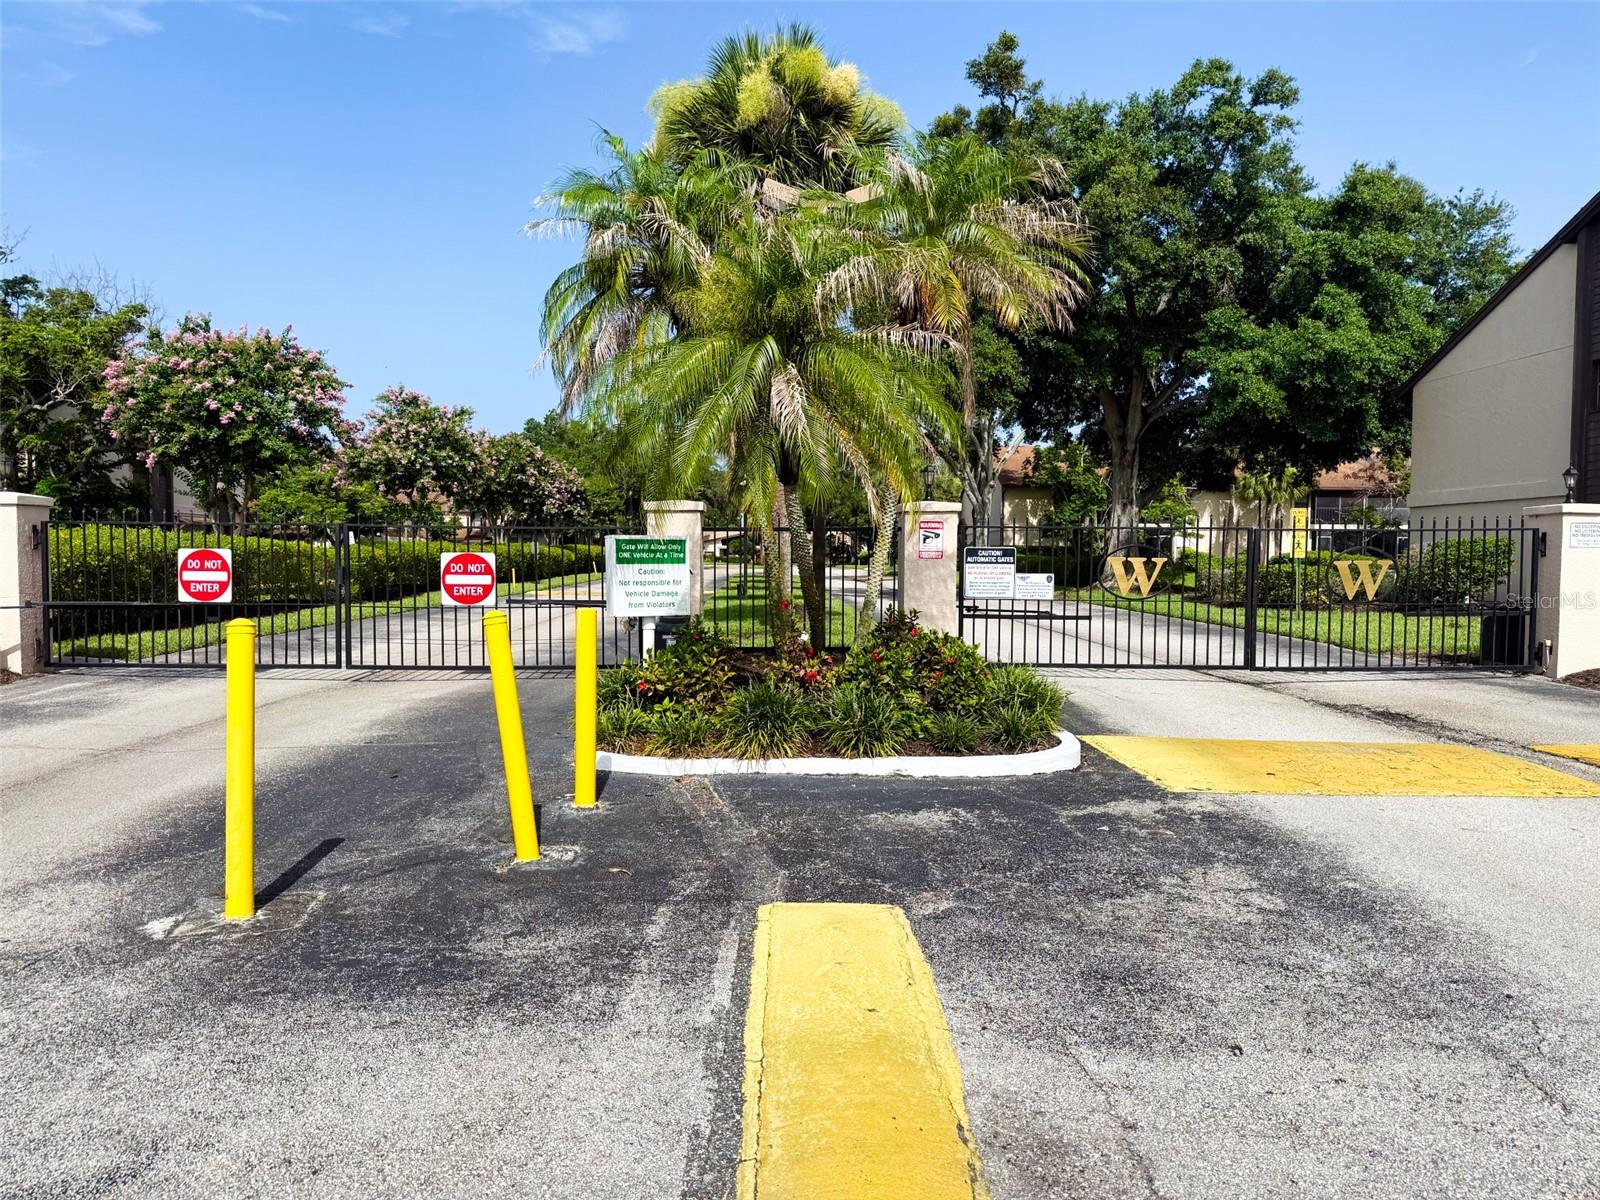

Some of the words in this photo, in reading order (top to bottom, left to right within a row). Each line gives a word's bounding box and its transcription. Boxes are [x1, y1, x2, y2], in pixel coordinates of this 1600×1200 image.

[667, 543, 681, 552] Only
[187, 559, 201, 569] DO
[204, 559, 223, 569] NOT
[450, 563, 464, 573] DO
[467, 563, 486, 573] NOT
[1106, 556, 1168, 598] W
[1333, 560, 1394, 601] W
[190, 582, 220, 593] ENTER
[632, 579, 671, 587] responsible
[453, 586, 484, 596] ENTER
[625, 590, 650, 598] Vehicle
[628, 601, 645, 609] from
[646, 601, 676, 609] Violators
